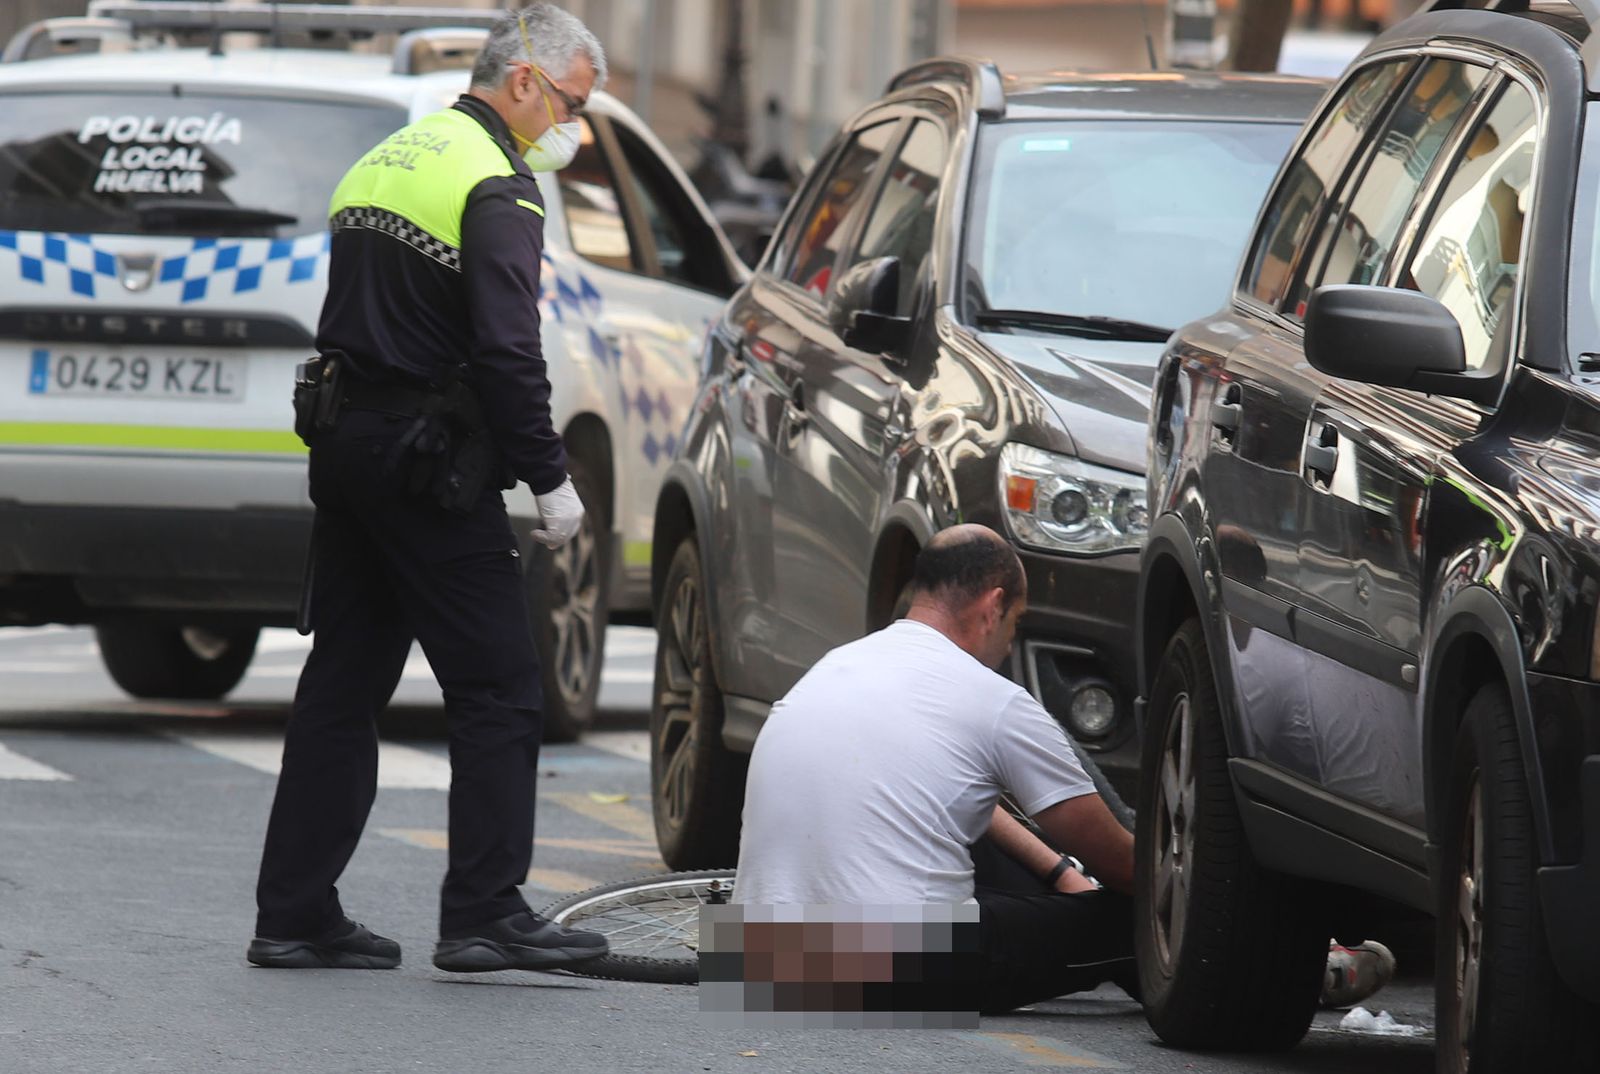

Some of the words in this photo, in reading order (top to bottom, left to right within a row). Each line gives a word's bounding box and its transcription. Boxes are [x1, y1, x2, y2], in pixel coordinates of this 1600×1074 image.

[78, 112, 242, 144] POLICÍA
[101, 146, 207, 171] LOCAL
[94, 170, 204, 193] HUELVA
[24, 314, 249, 339] DUSTER
[55, 355, 150, 392] 0429
[163, 357, 233, 394] KZL
